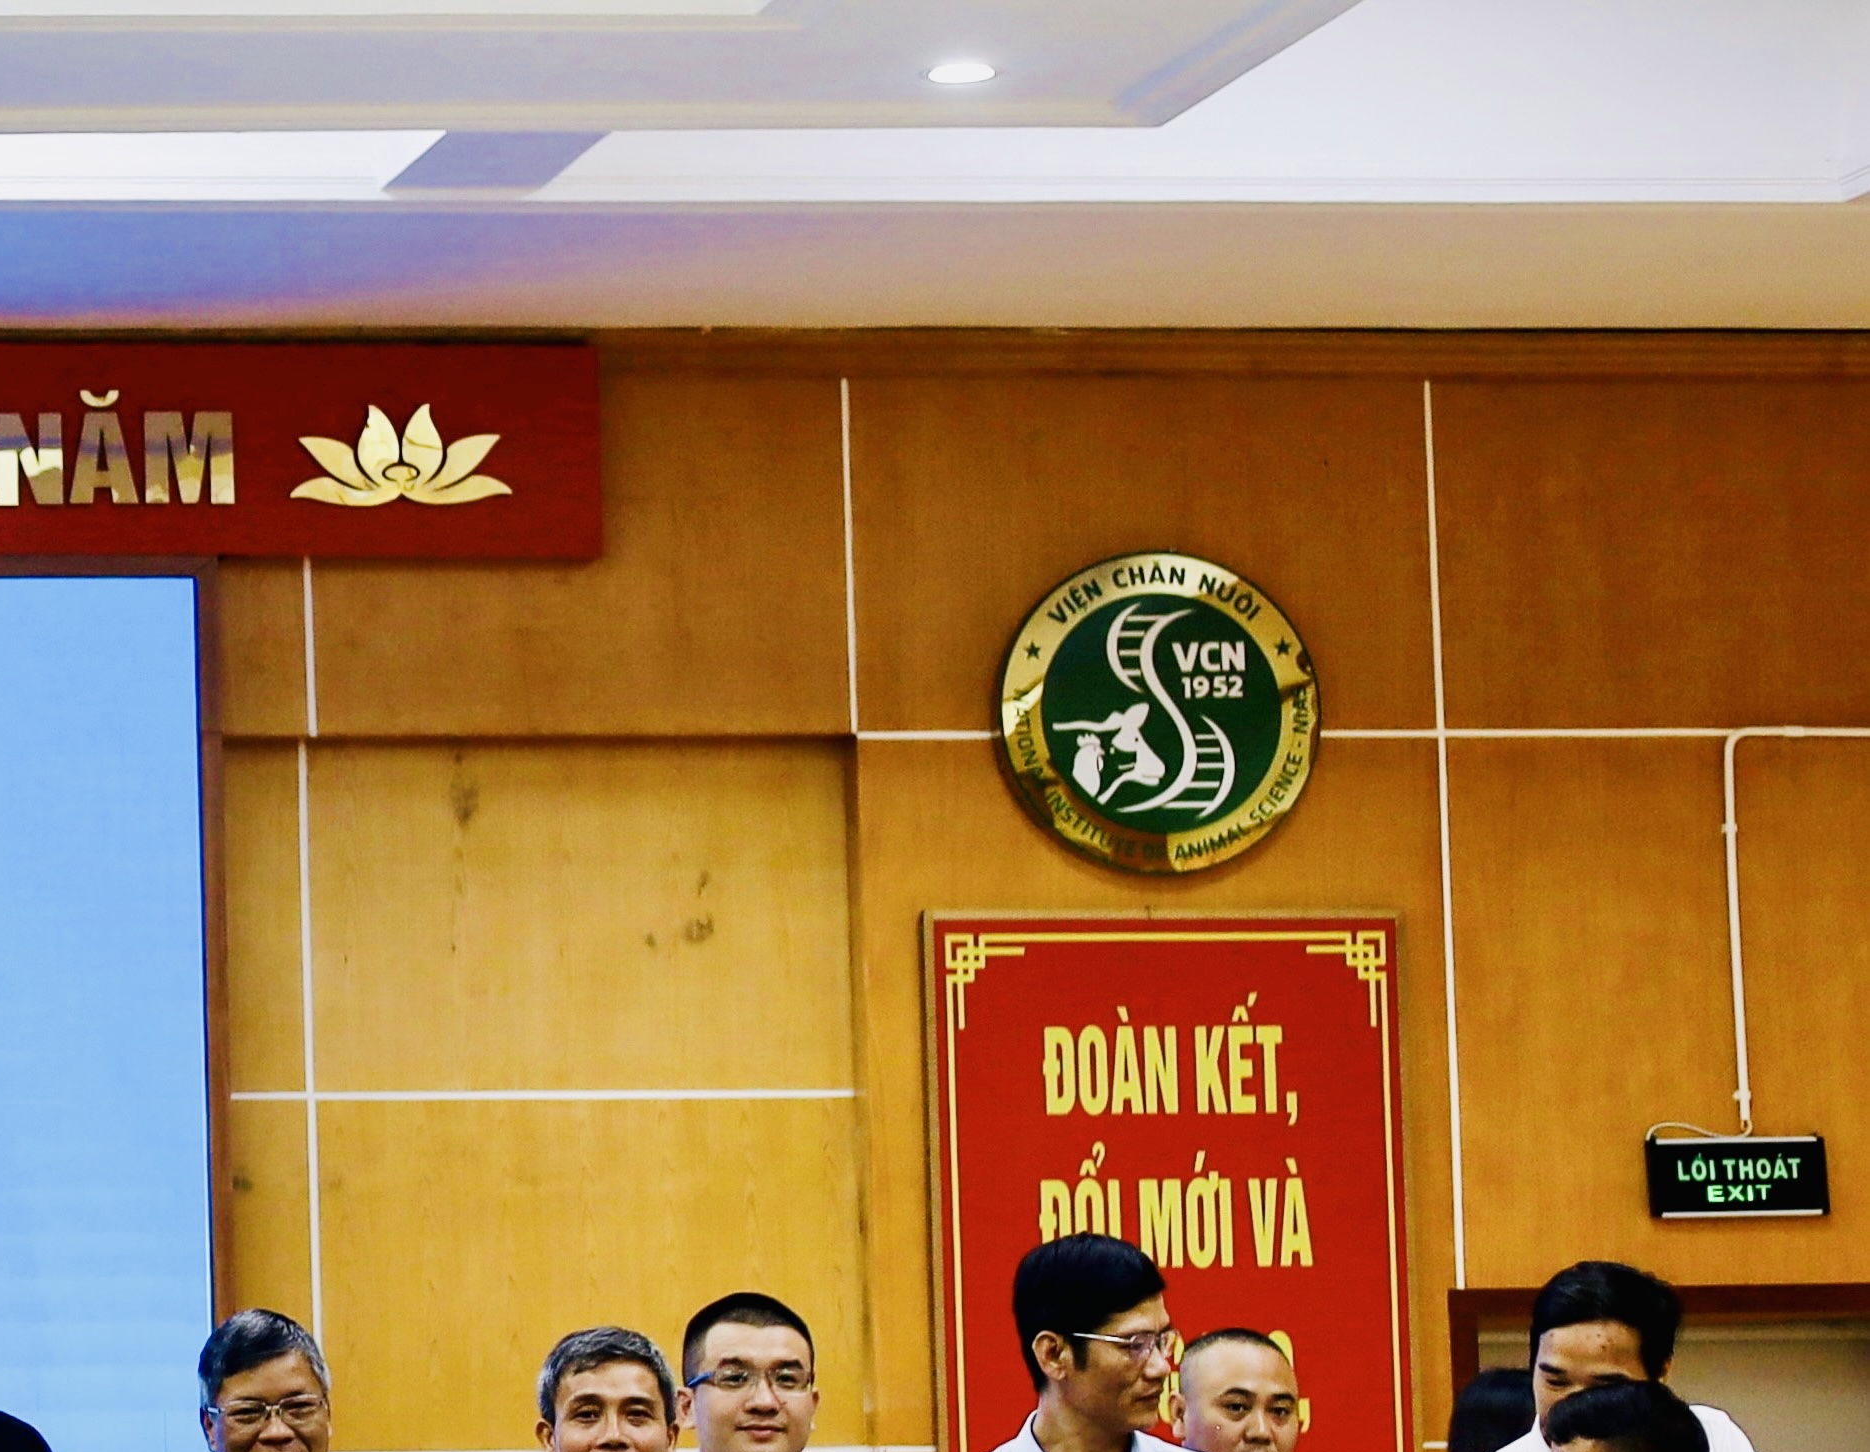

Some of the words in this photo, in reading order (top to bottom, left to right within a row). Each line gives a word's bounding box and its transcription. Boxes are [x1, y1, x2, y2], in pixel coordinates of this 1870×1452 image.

[1198, 573, 1262, 622] NUÔI
[1171, 641, 1247, 673] VCN
[1181, 675, 1245, 700] 1952
[1175, 823, 1250, 861] ANIMAL
[1250, 751, 1303, 824] SCIENCE
[1043, 1005, 1179, 1116] ĐOÀN
[1194, 991, 1298, 1126] KẾT,
[1677, 1153, 1716, 1181] LỐI
[1722, 1153, 1801, 1181] THOÁT
[1039, 1141, 1122, 1245] ĐỔI
[1138, 1150, 1234, 1269] MỚI
[1247, 1157, 1314, 1268] VÀ
[1707, 1184, 1772, 1203] EXIT
